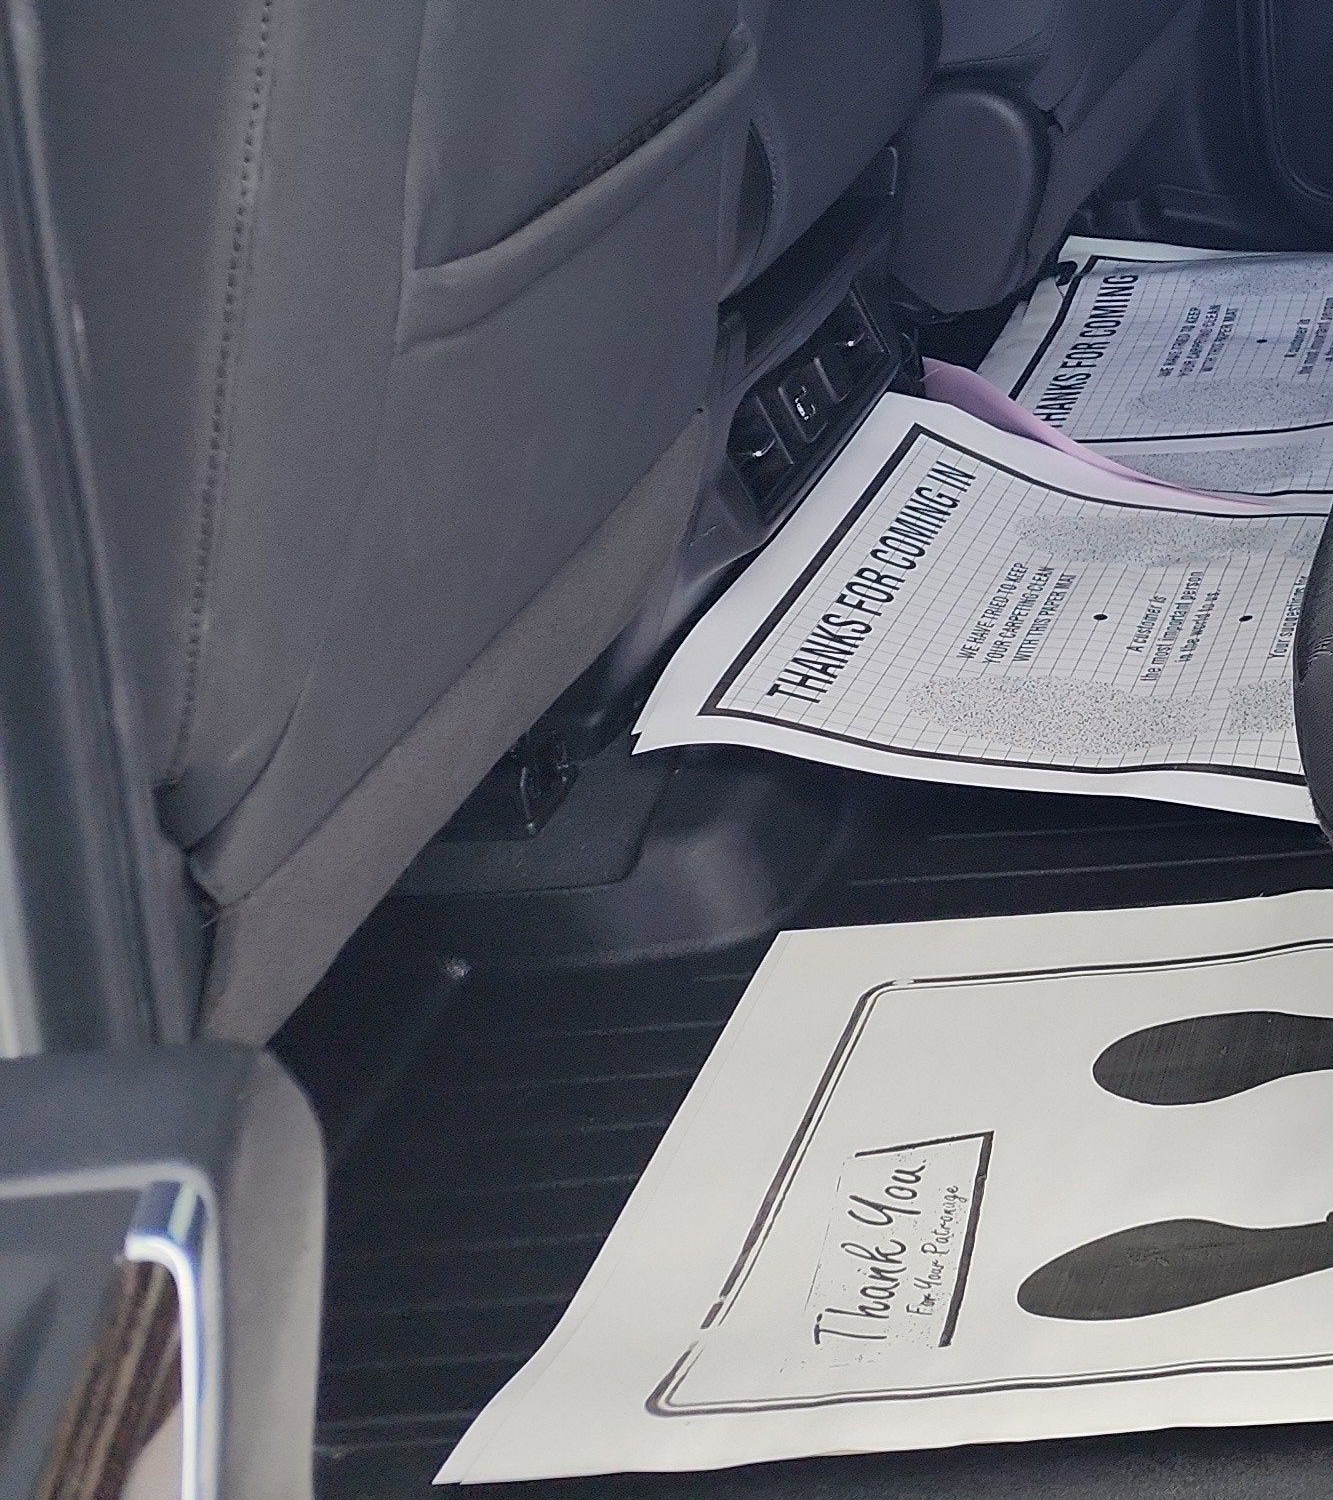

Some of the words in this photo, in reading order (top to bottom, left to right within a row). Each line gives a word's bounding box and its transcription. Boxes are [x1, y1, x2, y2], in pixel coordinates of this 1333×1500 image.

[1079, 275, 1138, 337] COMING
[1060, 342, 1110, 368] FOR
[927, 460, 976, 493] IN
[870, 486, 960, 570] COMING
[1006, 562, 1028, 583] KEEP
[1054, 573, 1077, 590] MAT
[836, 567, 906, 617] FOR
[997, 583, 1017, 594] TO
[1181, 571, 1203, 601] person
[981, 596, 1009, 621] TRIED
[982, 640, 1012, 664] YOUR
[999, 592, 1039, 639] CARPETING
[1027, 566, 1055, 592] CLEAN
[1039, 591, 1067, 618] PAPER
[967, 621, 994, 644] HAVE
[1027, 617, 1052, 636] THIS
[1133, 603, 1161, 644] customer
[1157, 602, 1192, 642] important
[957, 644, 980, 659] WE
[1012, 639, 1039, 662] WITH
[1126, 644, 1144, 652] A
[1151, 644, 1172, 664] most
[1180, 637, 1200, 651] the
[1268, 638, 1290, 659] Your
[766, 613, 872, 703] THANKS
[1174, 652, 1194, 663] in
[1140, 667, 1162, 681] the
[920, 1185, 968, 1256] Patronage
[913, 1260, 945, 1289] Your
[814, 1239, 907, 1345] Thank
[905, 1293, 936, 1316] For
